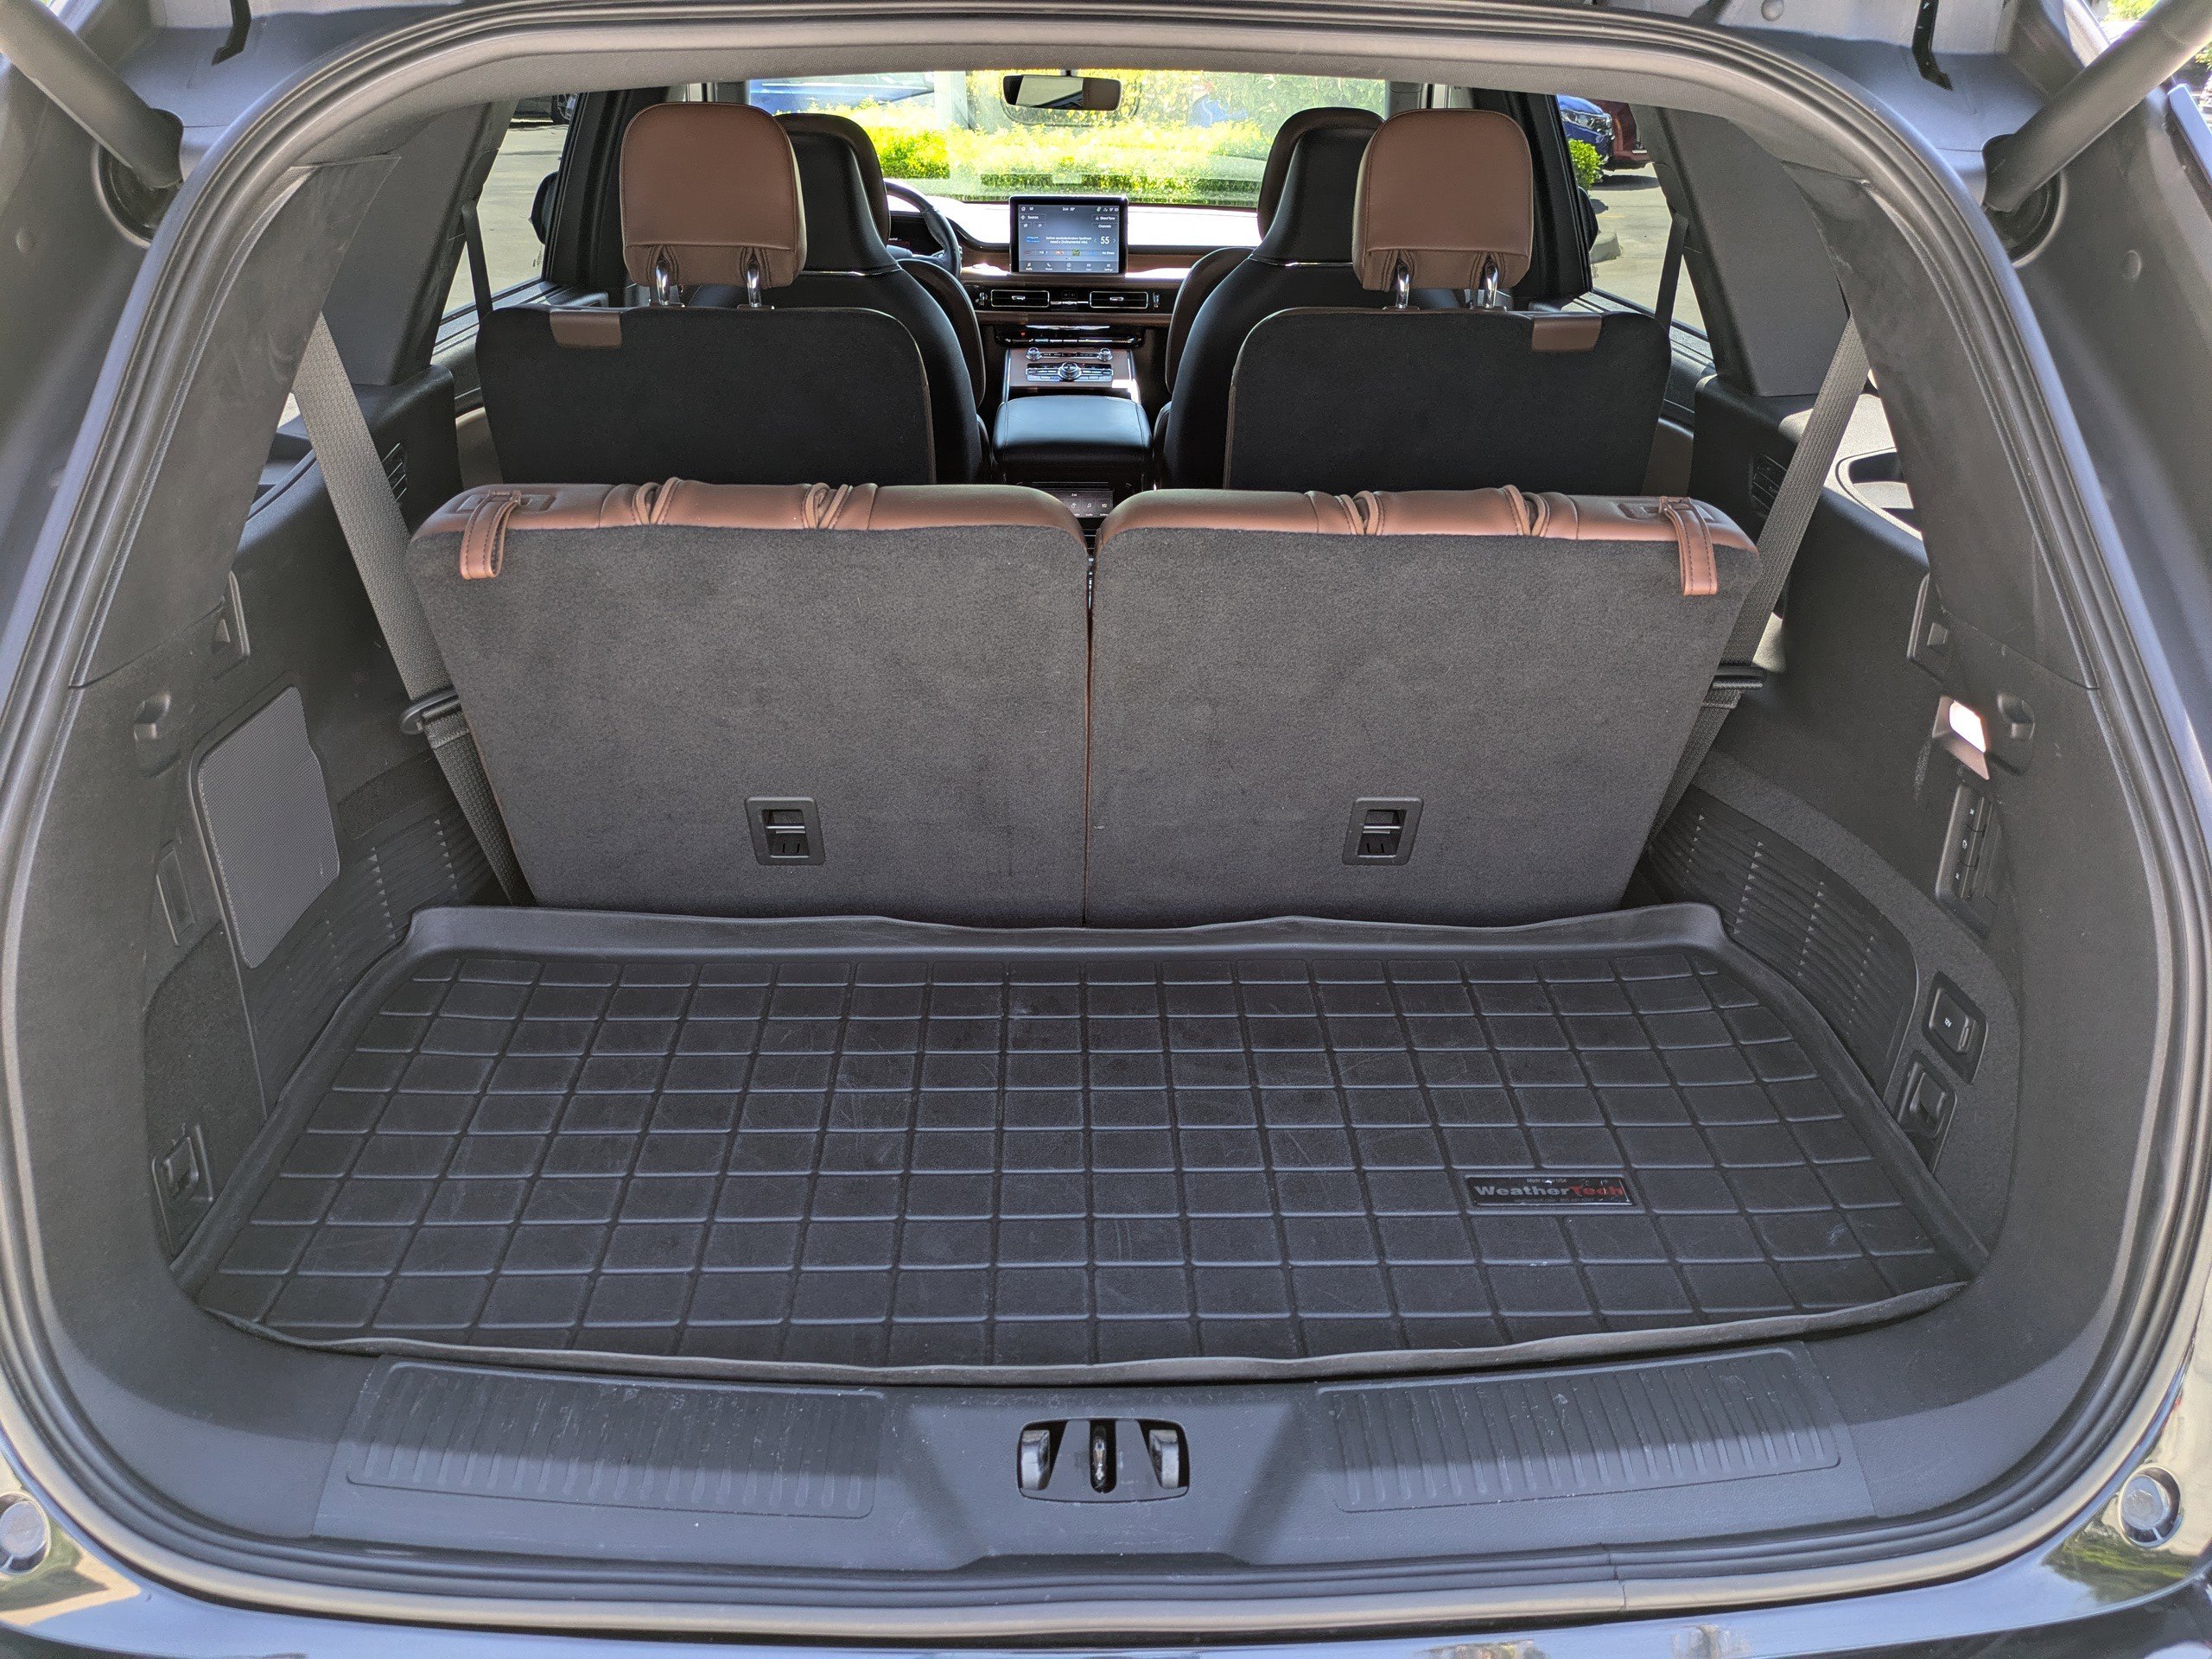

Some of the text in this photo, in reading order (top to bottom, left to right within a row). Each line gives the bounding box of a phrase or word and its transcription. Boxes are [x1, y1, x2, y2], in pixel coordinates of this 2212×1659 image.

[1100, 236, 1110, 245] 55
[1944, 1017, 1953, 1028] 12V
[1473, 1184, 1624, 1196] WeatherTech
